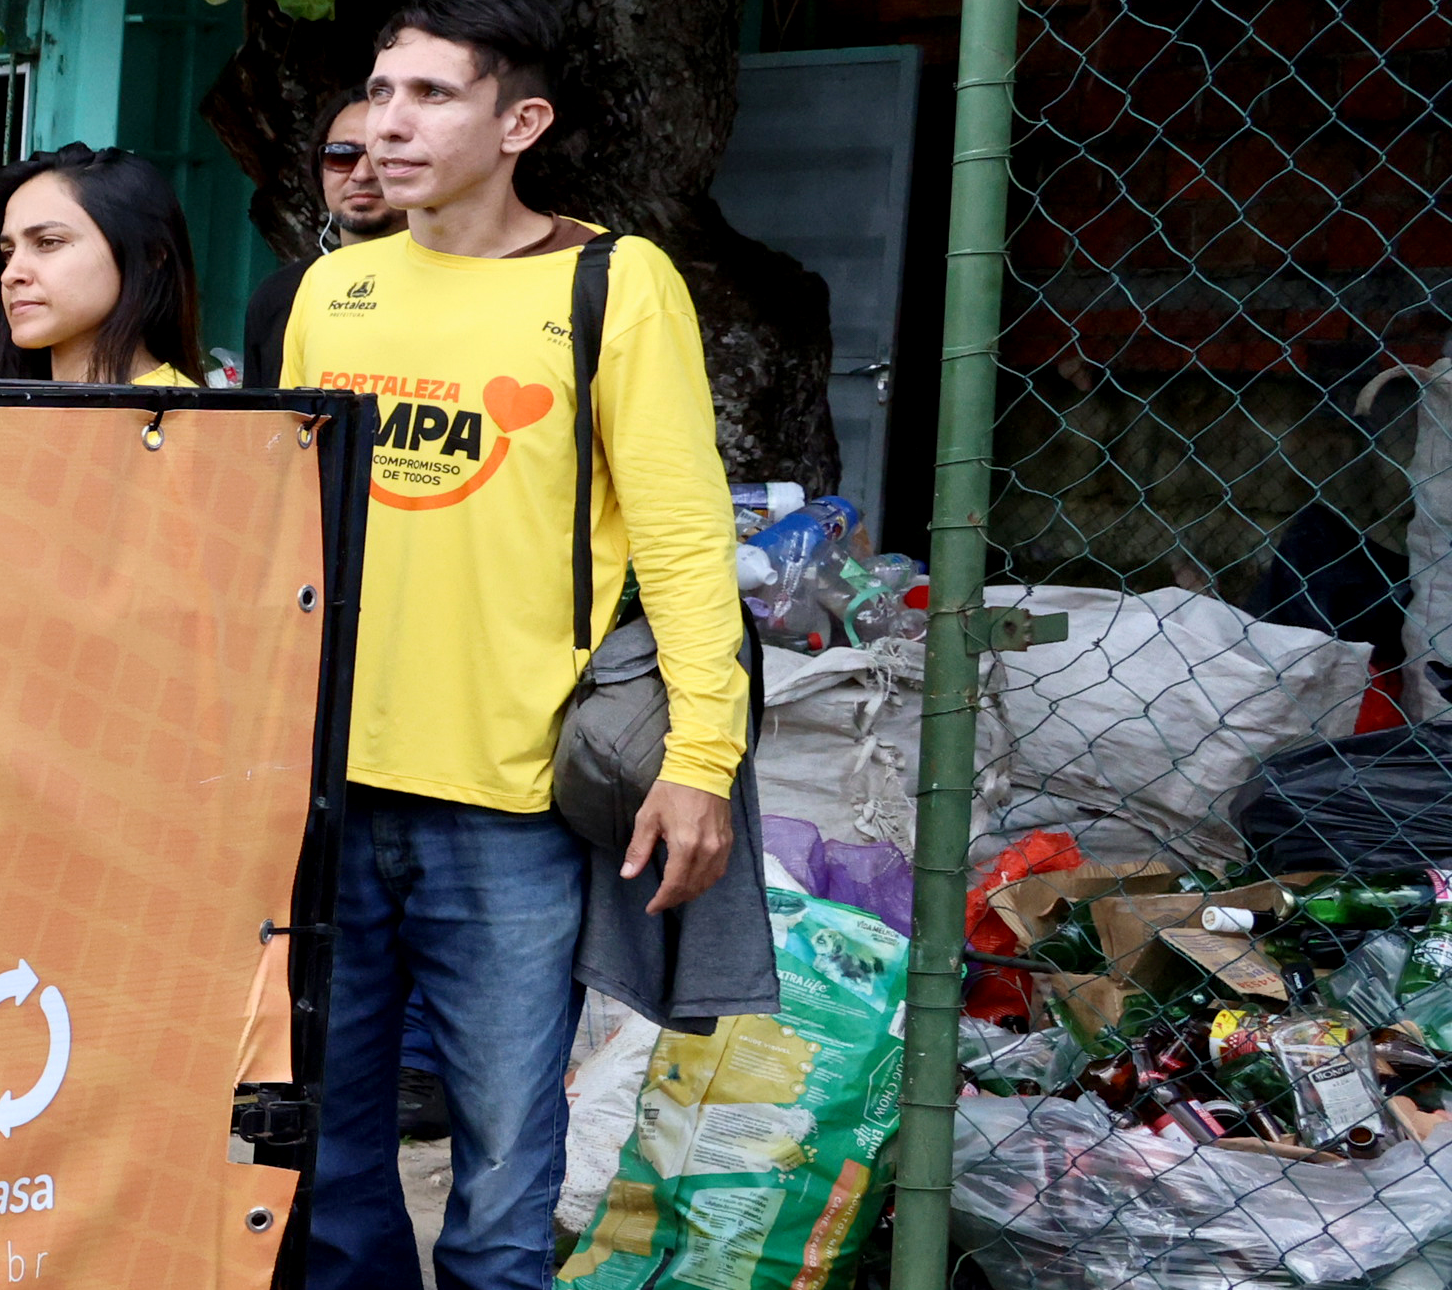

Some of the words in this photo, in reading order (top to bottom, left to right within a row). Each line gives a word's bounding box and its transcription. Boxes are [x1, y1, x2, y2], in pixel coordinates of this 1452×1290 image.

[328, 300, 378, 311] Fortaleza
[319, 371, 461, 403] FORTALEZA
[374, 401, 482, 461] MPA
[373, 454, 461, 475] COMPROMISSO
[382, 469, 400, 480] DE
[403, 470, 442, 486] TODOS
